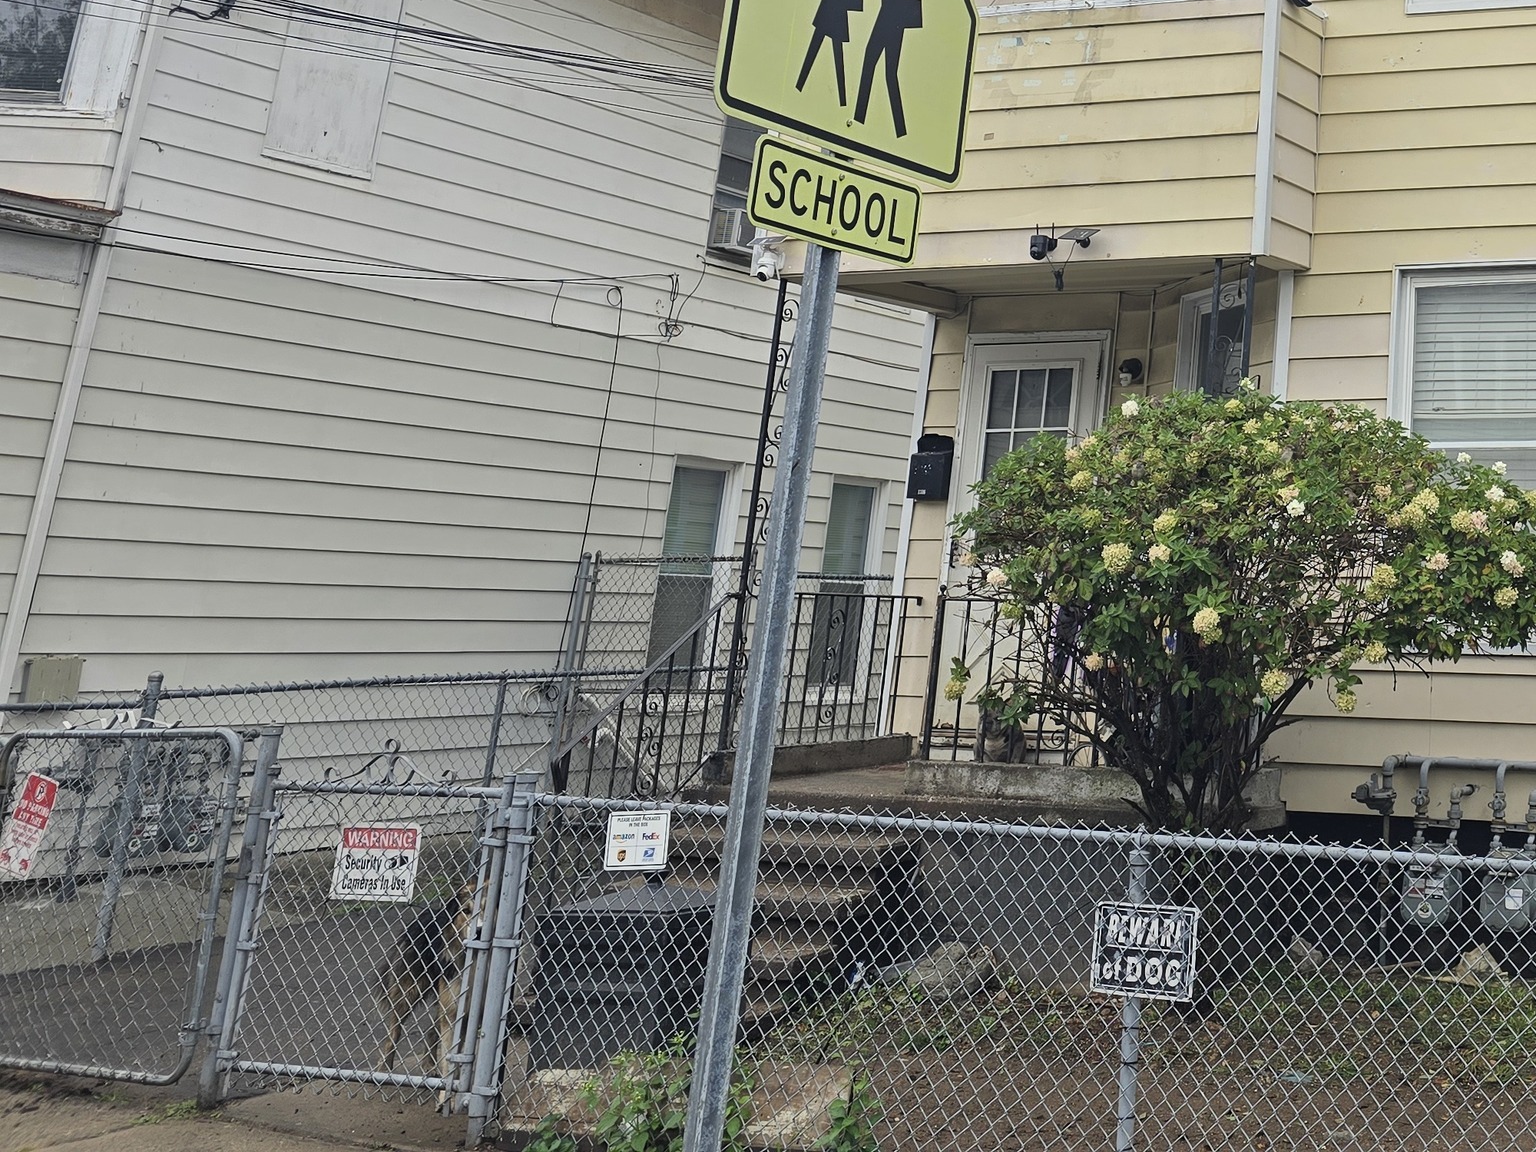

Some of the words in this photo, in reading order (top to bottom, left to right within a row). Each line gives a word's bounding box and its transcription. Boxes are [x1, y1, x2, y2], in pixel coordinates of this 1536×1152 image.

[764, 160, 906, 246] SCHOOL
[348, 830, 413, 847] WARNING
[613, 833, 635, 841] amazon
[642, 832, 660, 840] FedEx
[345, 854, 382, 873] Security
[342, 875, 379, 890] Cameras
[391, 875, 406, 891] Use
[1103, 952, 1122, 981] of
[1126, 956, 1182, 987] DOG
